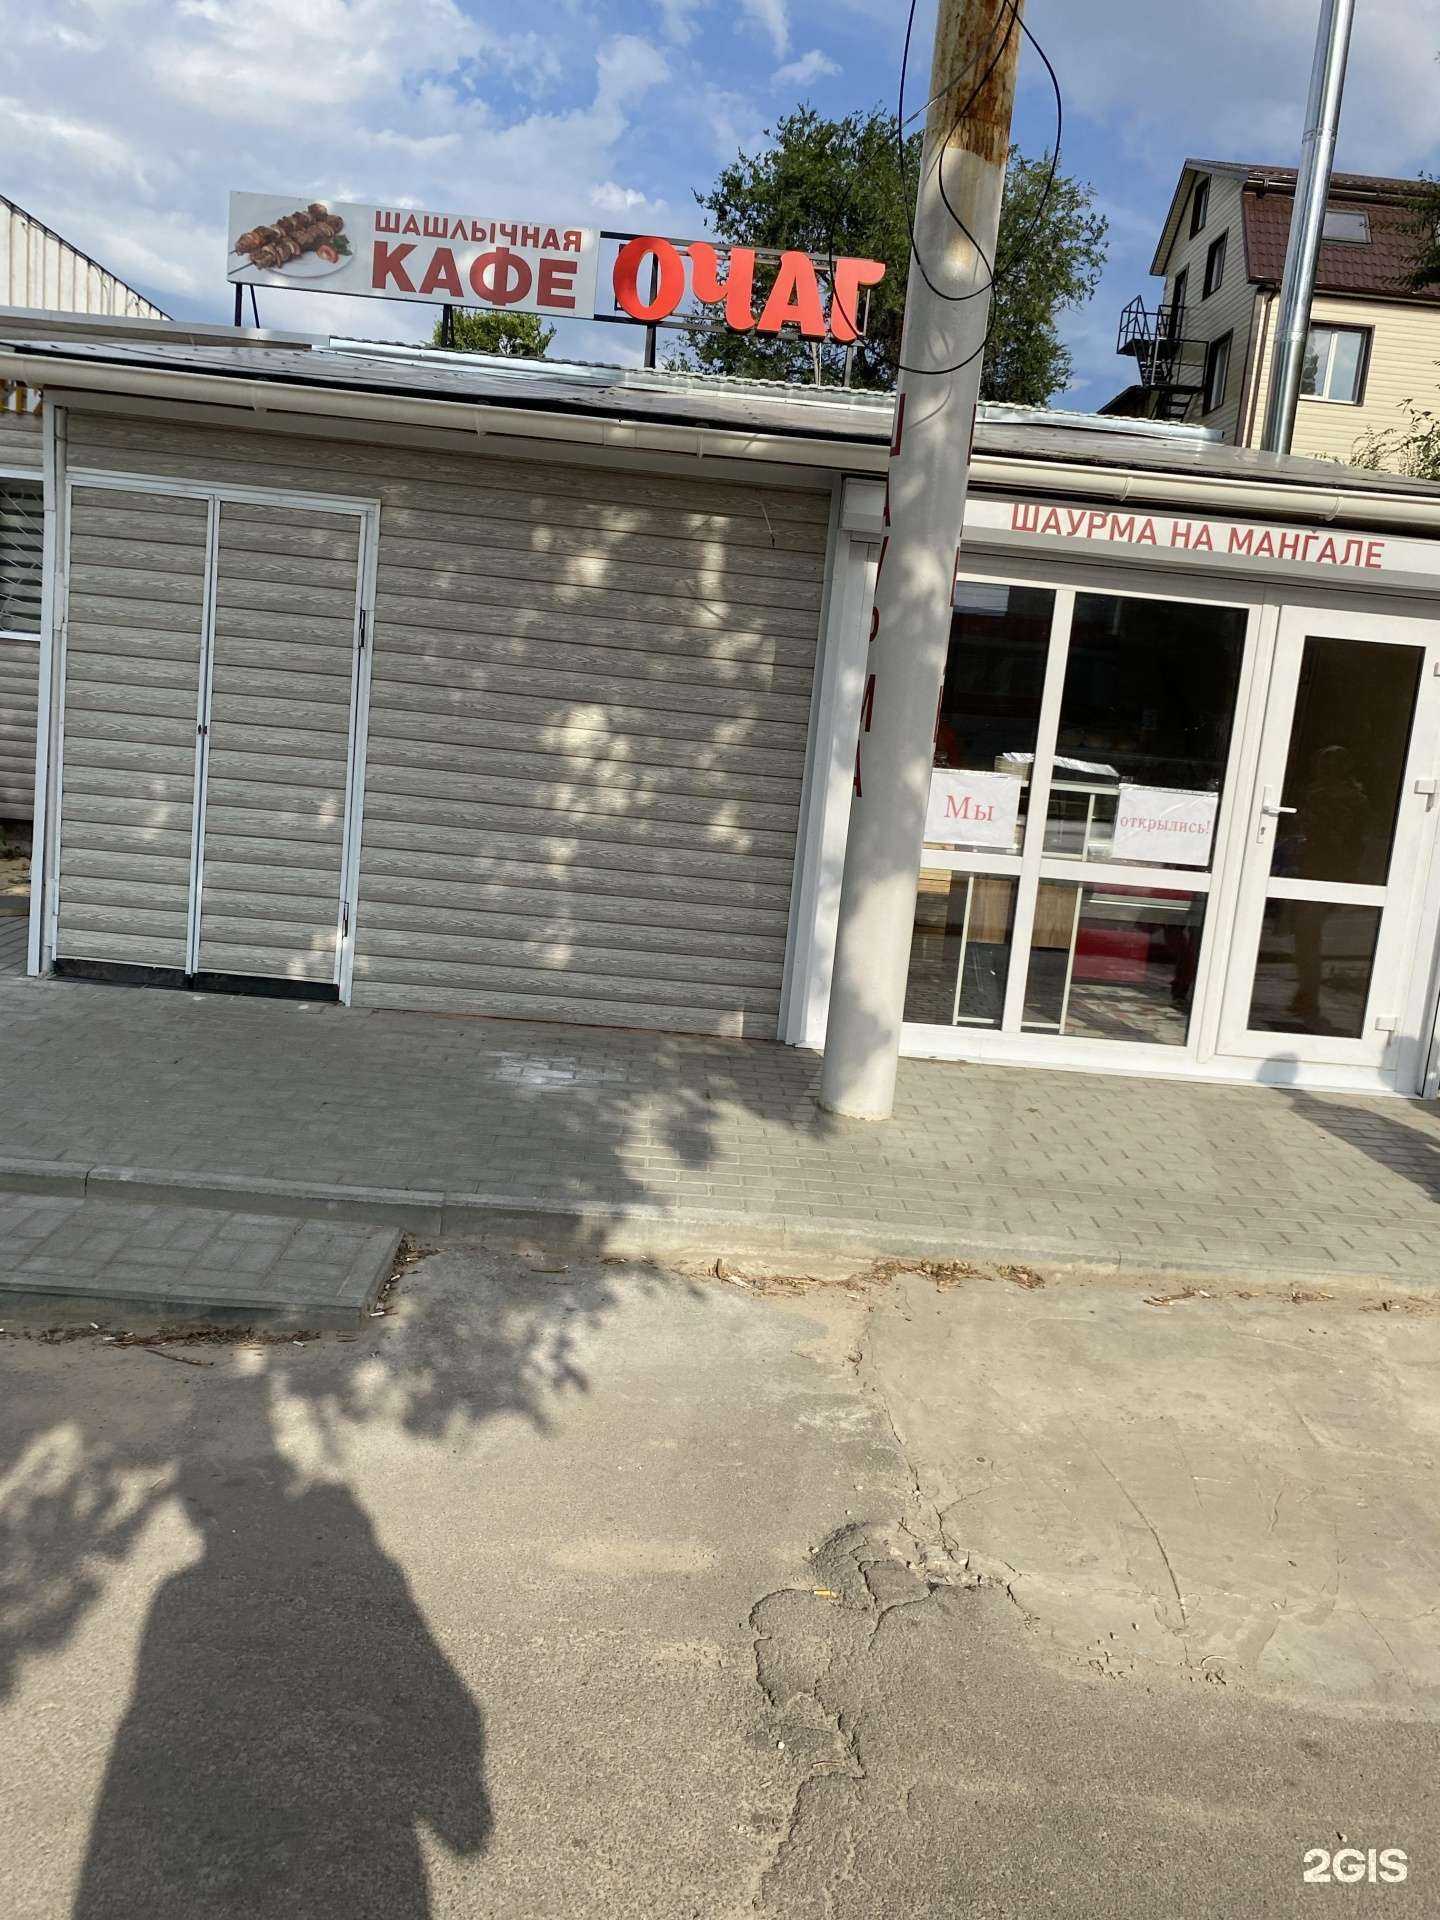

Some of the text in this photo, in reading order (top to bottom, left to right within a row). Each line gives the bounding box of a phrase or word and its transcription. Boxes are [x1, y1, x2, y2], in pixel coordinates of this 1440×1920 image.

[375, 210, 582, 252] ШАШЛЫЧНАЯ
[372, 240, 578, 309] КАФЕ
[613, 236, 886, 342] ОЧАГ
[1011, 503, 1385, 569] ШАУРМА НА МАНГАЛЕ
[944, 794, 994, 822] Мы
[1120, 815, 1211, 835] открылись!
